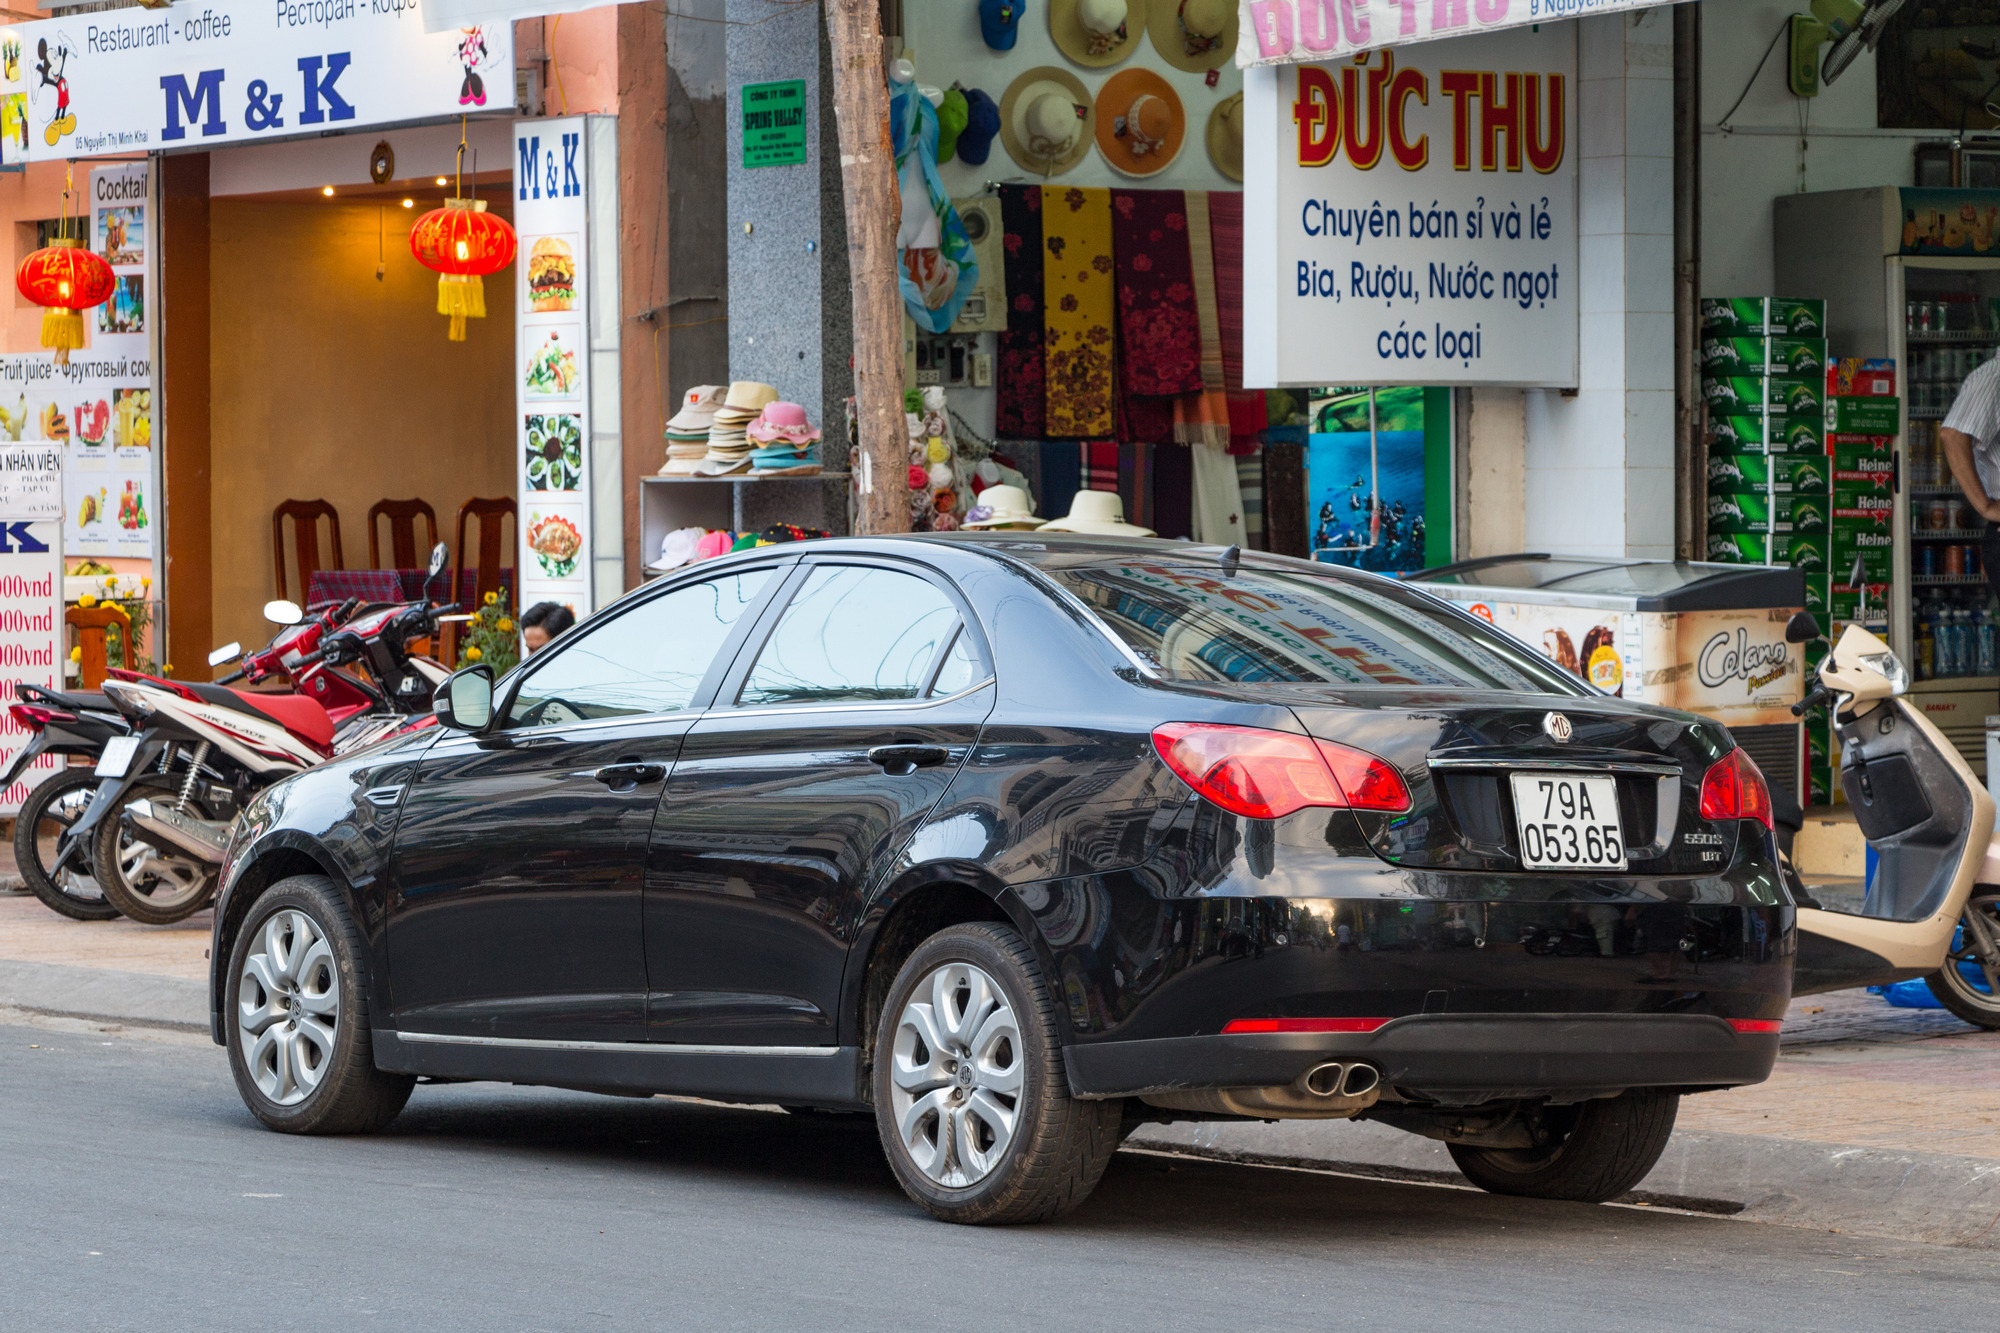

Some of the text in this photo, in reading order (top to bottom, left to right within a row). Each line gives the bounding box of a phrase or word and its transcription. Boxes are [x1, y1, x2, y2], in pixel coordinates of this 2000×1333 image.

[88, 17, 170, 54] Restaurant
[185, 9, 231, 42] coffee
[277, 0, 354, 29] Ресторан
[160, 51, 355, 141] M & K
[1292, 49, 1566, 174] ĐỨC THU
[745, 107, 802, 130] SPRING VALLEY
[75, 137, 83, 149] 05
[119, 131, 133, 144] Minh
[134, 129, 149, 143] Khai
[519, 132, 580, 200] M & K
[97, 173, 148, 201] Cocktail
[1302, 196, 1551, 246] Chuyên bán sỉ và lẻ
[1297, 260, 1559, 309] Bia, Rượu, Nước ngọt
[1377, 321, 1481, 367] các loại
[25, 358, 52, 385] juice
[62, 355, 128, 383] Фруктовый
[131, 360, 151, 378] сок
[6, 450, 34, 471] NHÂN
[37, 450, 60, 471] VIÊN
[0, 571, 52, 598] 00vnd
[1698, 627, 1787, 688] Celano
[1747, 666, 1787, 696] Passion
[1925, 703, 1957, 712] SANAKY
[1552, 717, 1570, 737] MG
[1538, 780, 1596, 822] 79A
[1524, 823, 1621, 865] 053.65
